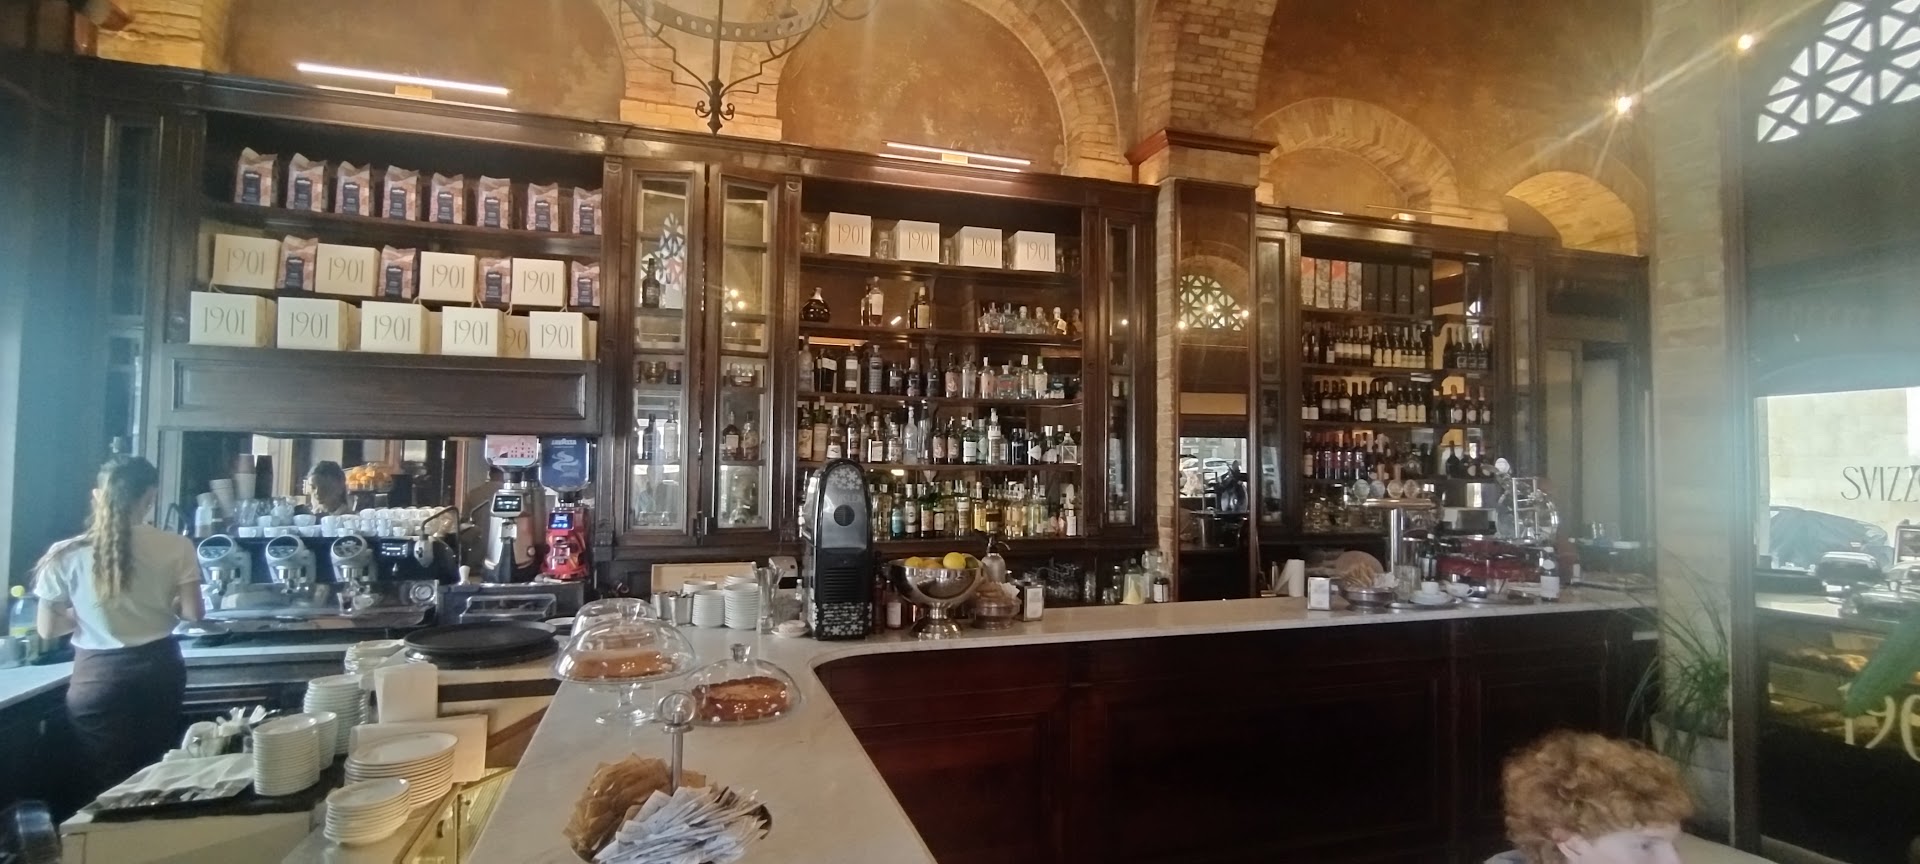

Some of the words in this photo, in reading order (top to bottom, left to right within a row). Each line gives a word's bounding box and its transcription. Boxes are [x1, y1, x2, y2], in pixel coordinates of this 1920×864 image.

[837, 223, 865, 246] 1901
[907, 231, 934, 252] 1901
[971, 236, 997, 258] 1901
[226, 247, 265, 276] 1901
[1025, 241, 1050, 263] 1901
[328, 256, 365, 283] 1901
[431, 263, 465, 289] 1901
[523, 270, 555, 295] 1901
[203, 306, 246, 335] 1901
[290, 311, 329, 340] 1901
[374, 314, 411, 342] 1901
[453, 319, 489, 346] 1901
[504, 327, 529, 352] 90
[541, 323, 574, 349] 1901
[1840, 465, 1920, 502] SVIZZ
